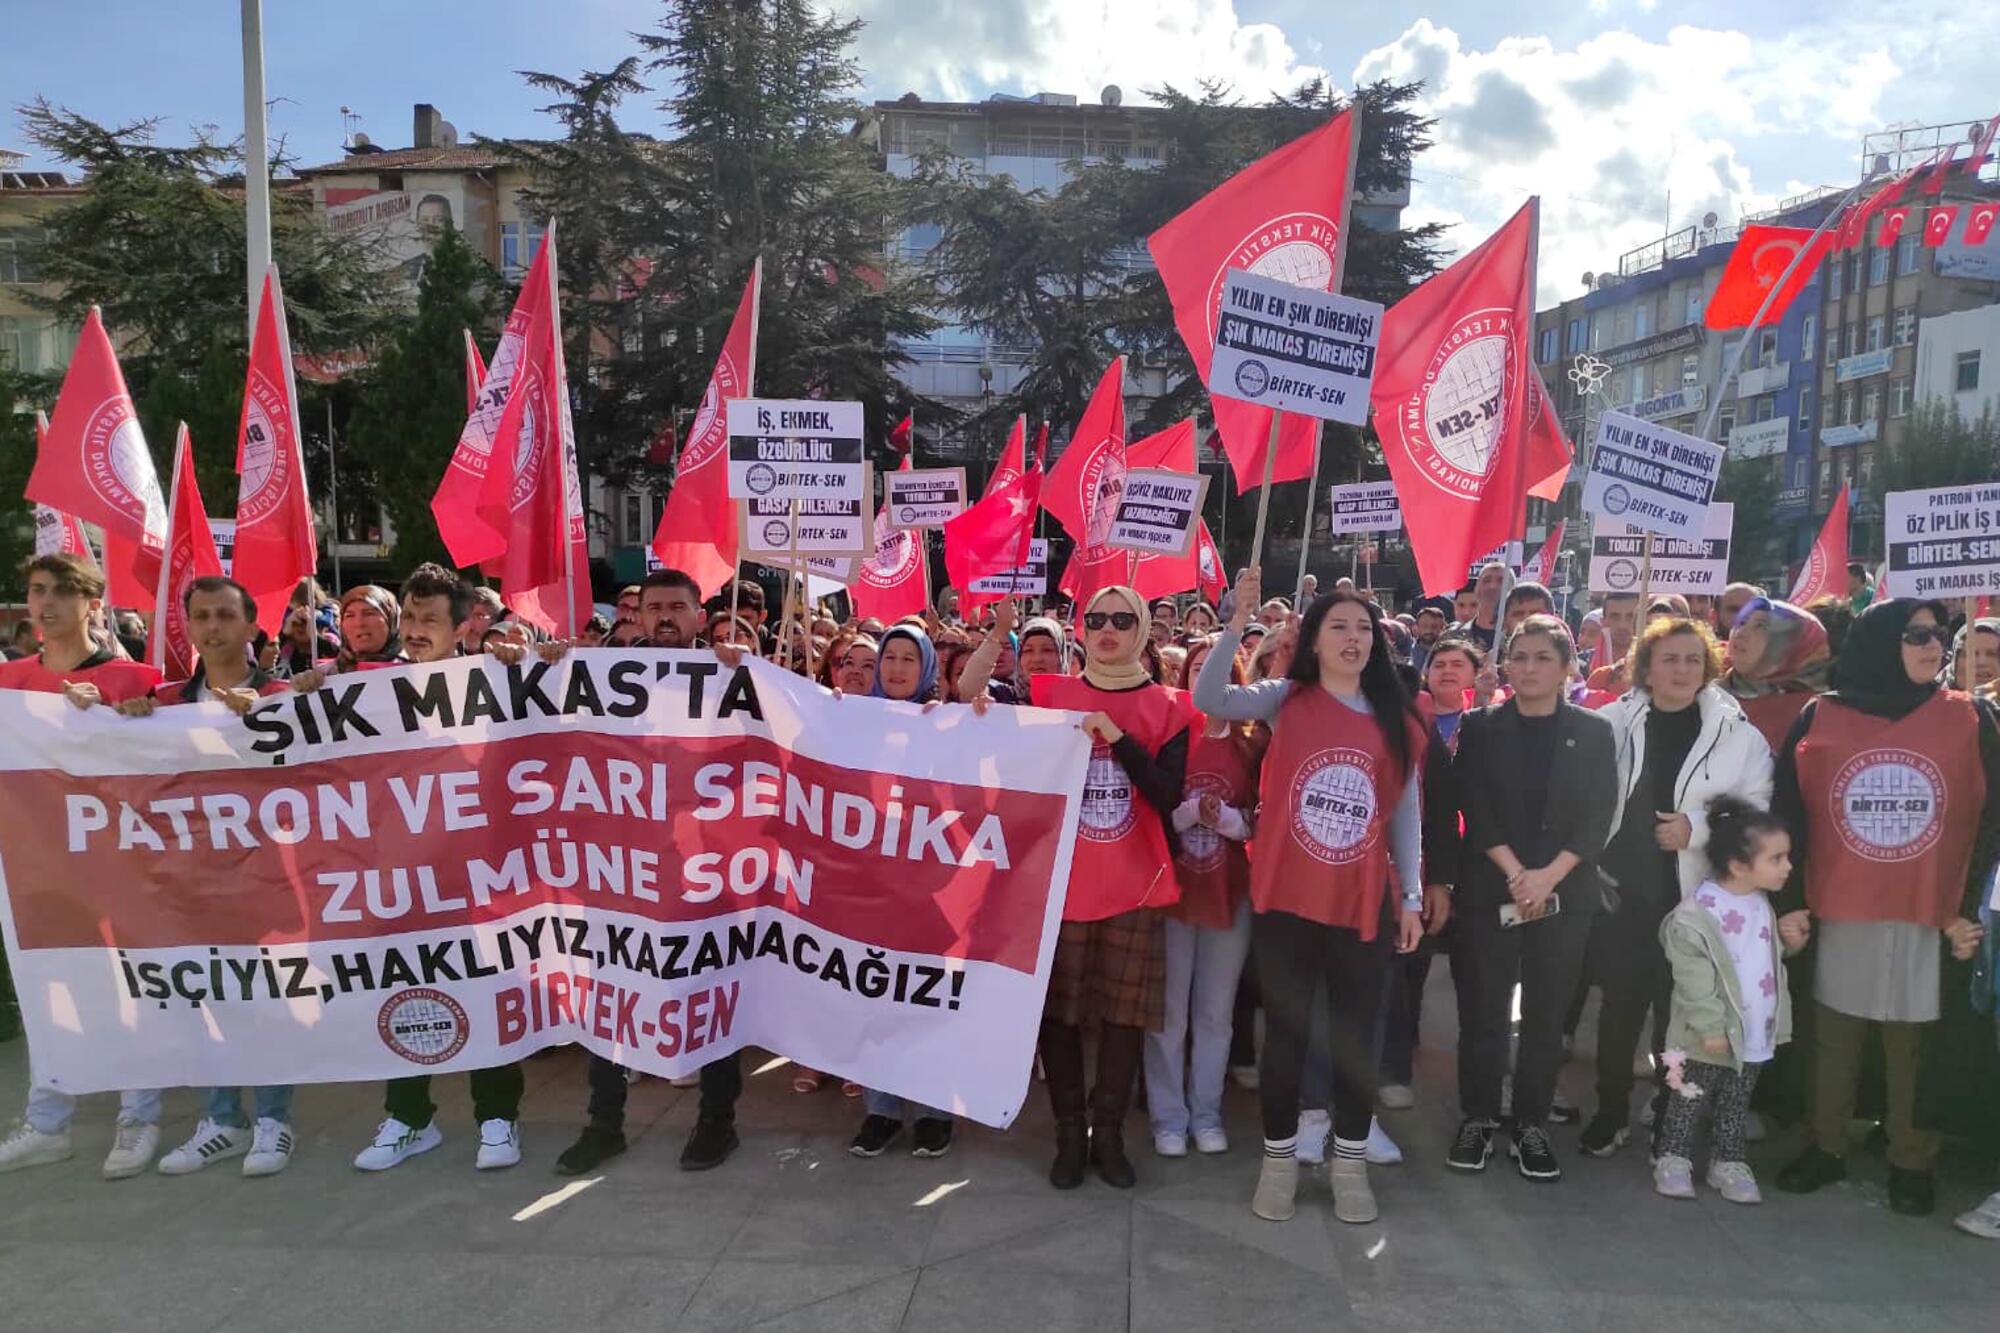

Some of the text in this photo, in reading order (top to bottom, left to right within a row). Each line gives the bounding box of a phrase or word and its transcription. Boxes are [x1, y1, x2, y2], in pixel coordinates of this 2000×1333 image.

[1231, 286, 1265, 313] YILIN
[1267, 296, 1286, 318] EN
[1288, 302, 1313, 327] ŞIK
[1225, 319, 1249, 346] ŞIK
[1251, 326, 1304, 356] MAKAS
[1269, 374, 1346, 406] BİRTEK-SEN
[780, 410, 834, 432] EKMEK,
[757, 437, 833, 461] ÖZGÜRLÜK!
[1634, 433, 1650, 452] EN
[1619, 456, 1662, 484] MAKAS
[1929, 491, 1973, 507] PATRON
[1906, 514, 1926, 534] ÖZ
[1930, 510, 1970, 533] İPLİK
[1975, 507, 1991, 534] İŞ
[1608, 539, 1641, 553] TOKAT
[1915, 578, 1936, 595] ŞIK
[1940, 574, 1986, 590] MAKAS
[243, 660, 764, 766] ŞIK MAKAS'TA
[65, 756, 1012, 870] PATRON VE SARI SENDİKA
[1850, 797, 1929, 813] BİRTEK-SEN
[317, 828, 814, 923] ZULMÜNE SON
[495, 962, 740, 1058] BİRTEK-SEN
